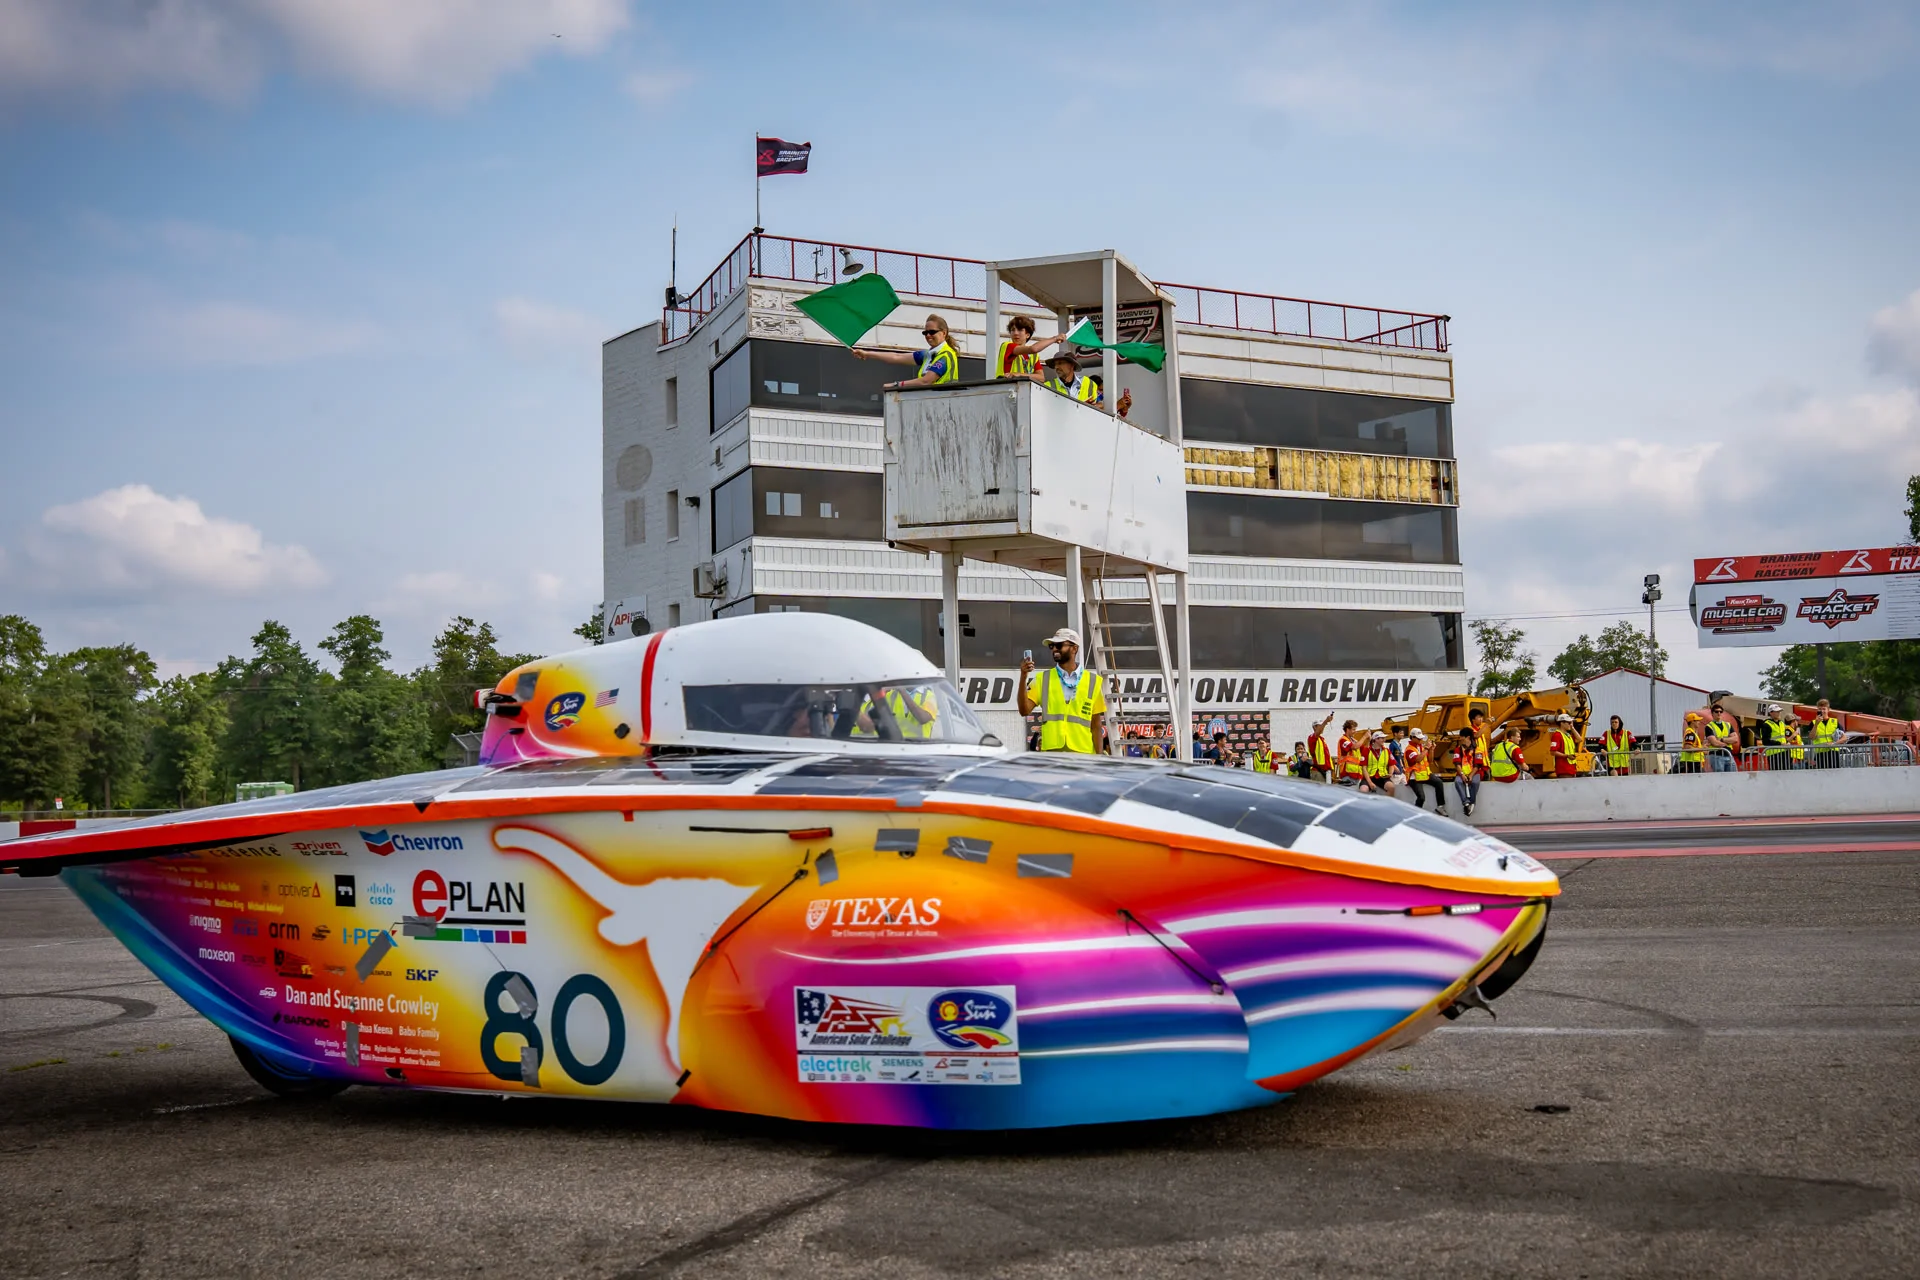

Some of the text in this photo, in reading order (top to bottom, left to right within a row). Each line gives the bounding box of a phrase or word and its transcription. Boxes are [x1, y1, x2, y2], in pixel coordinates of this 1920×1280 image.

[1760, 553, 1822, 563] BRAINERD
[1890, 547, 1919, 557] 2025
[1754, 567, 1818, 578] RACEWAY
[1704, 607, 1783, 618] MUSCLE CAR
[1801, 602, 1875, 614] BRACKET
[1280, 678, 1416, 703] RACEWAY
[296, 841, 341, 850] Driven
[392, 834, 463, 851] Chevron
[832, 898, 941, 926] TEXAS
[269, 922, 300, 940] arm
[843, 930, 876, 939] University
[406, 969, 439, 981] SKF
[285, 984, 307, 1004] Dan
[310, 988, 331, 1007] and
[334, 990, 384, 1012] Suzanne
[387, 994, 439, 1021] Crowley
[283, 1014, 330, 1028] SARONIC
[480, 971, 626, 1086] 80
[809, 1034, 912, 1046] American Solar Challenge
[800, 1056, 871, 1072] electrek
[881, 1058, 924, 1067] SIEMENS
